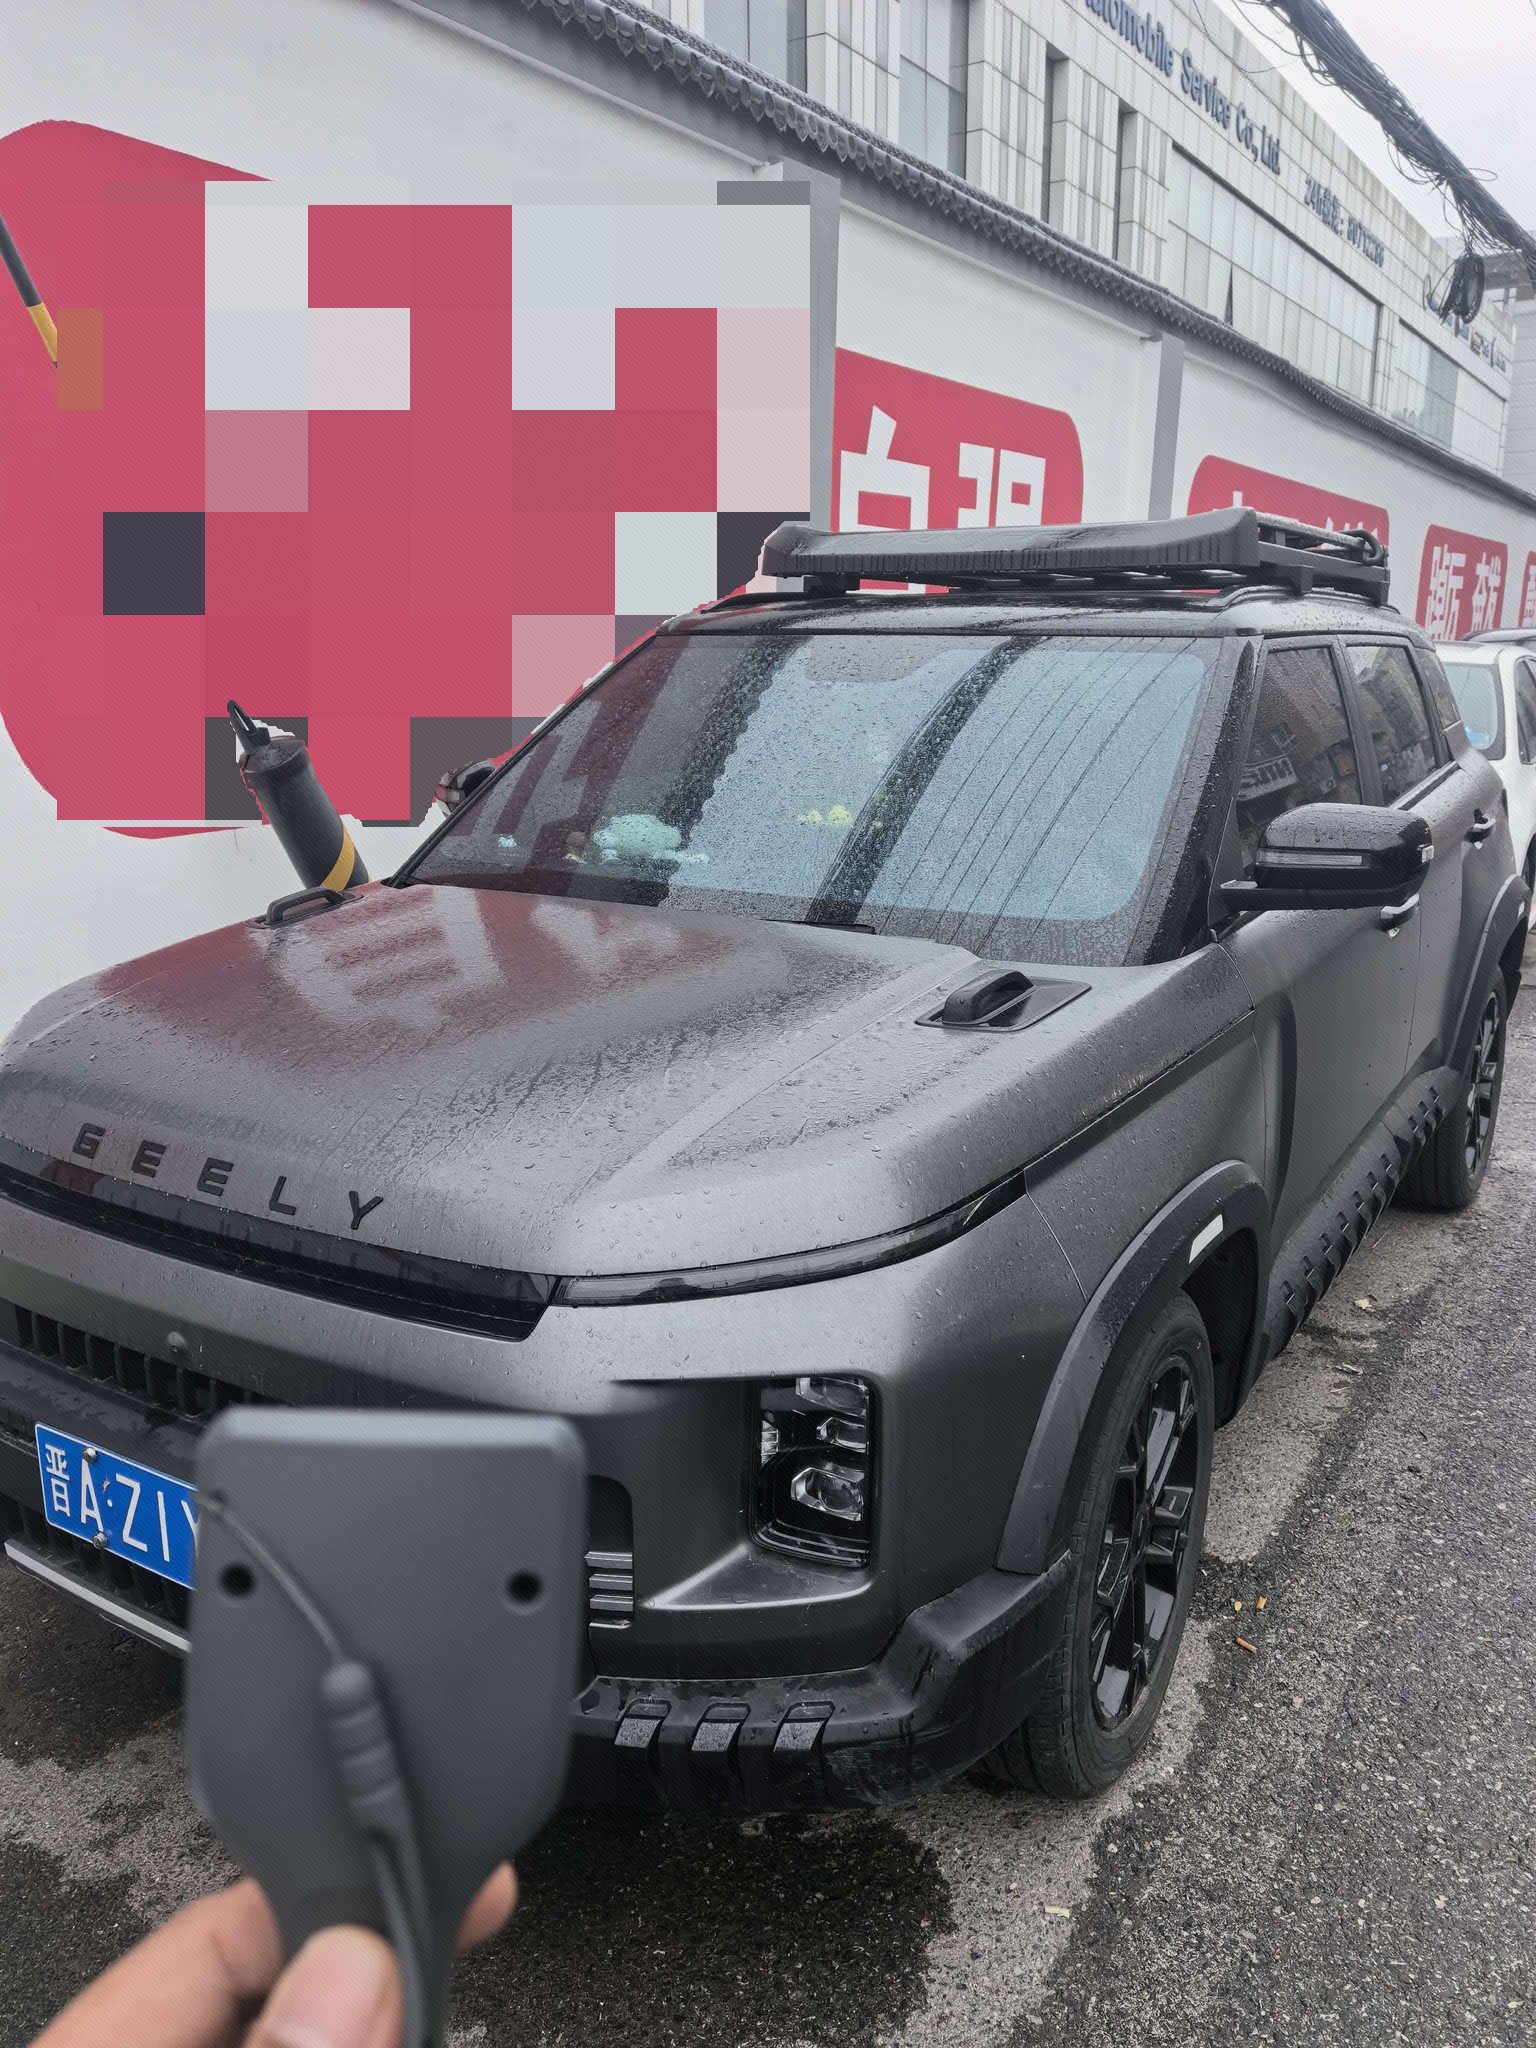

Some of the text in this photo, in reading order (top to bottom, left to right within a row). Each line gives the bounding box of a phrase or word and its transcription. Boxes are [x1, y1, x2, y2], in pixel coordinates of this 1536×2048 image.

[1085, 0, 1174, 77] utomobile
[1180, 48, 1230, 129] Service
[72, 1122, 384, 1230] GEELY
